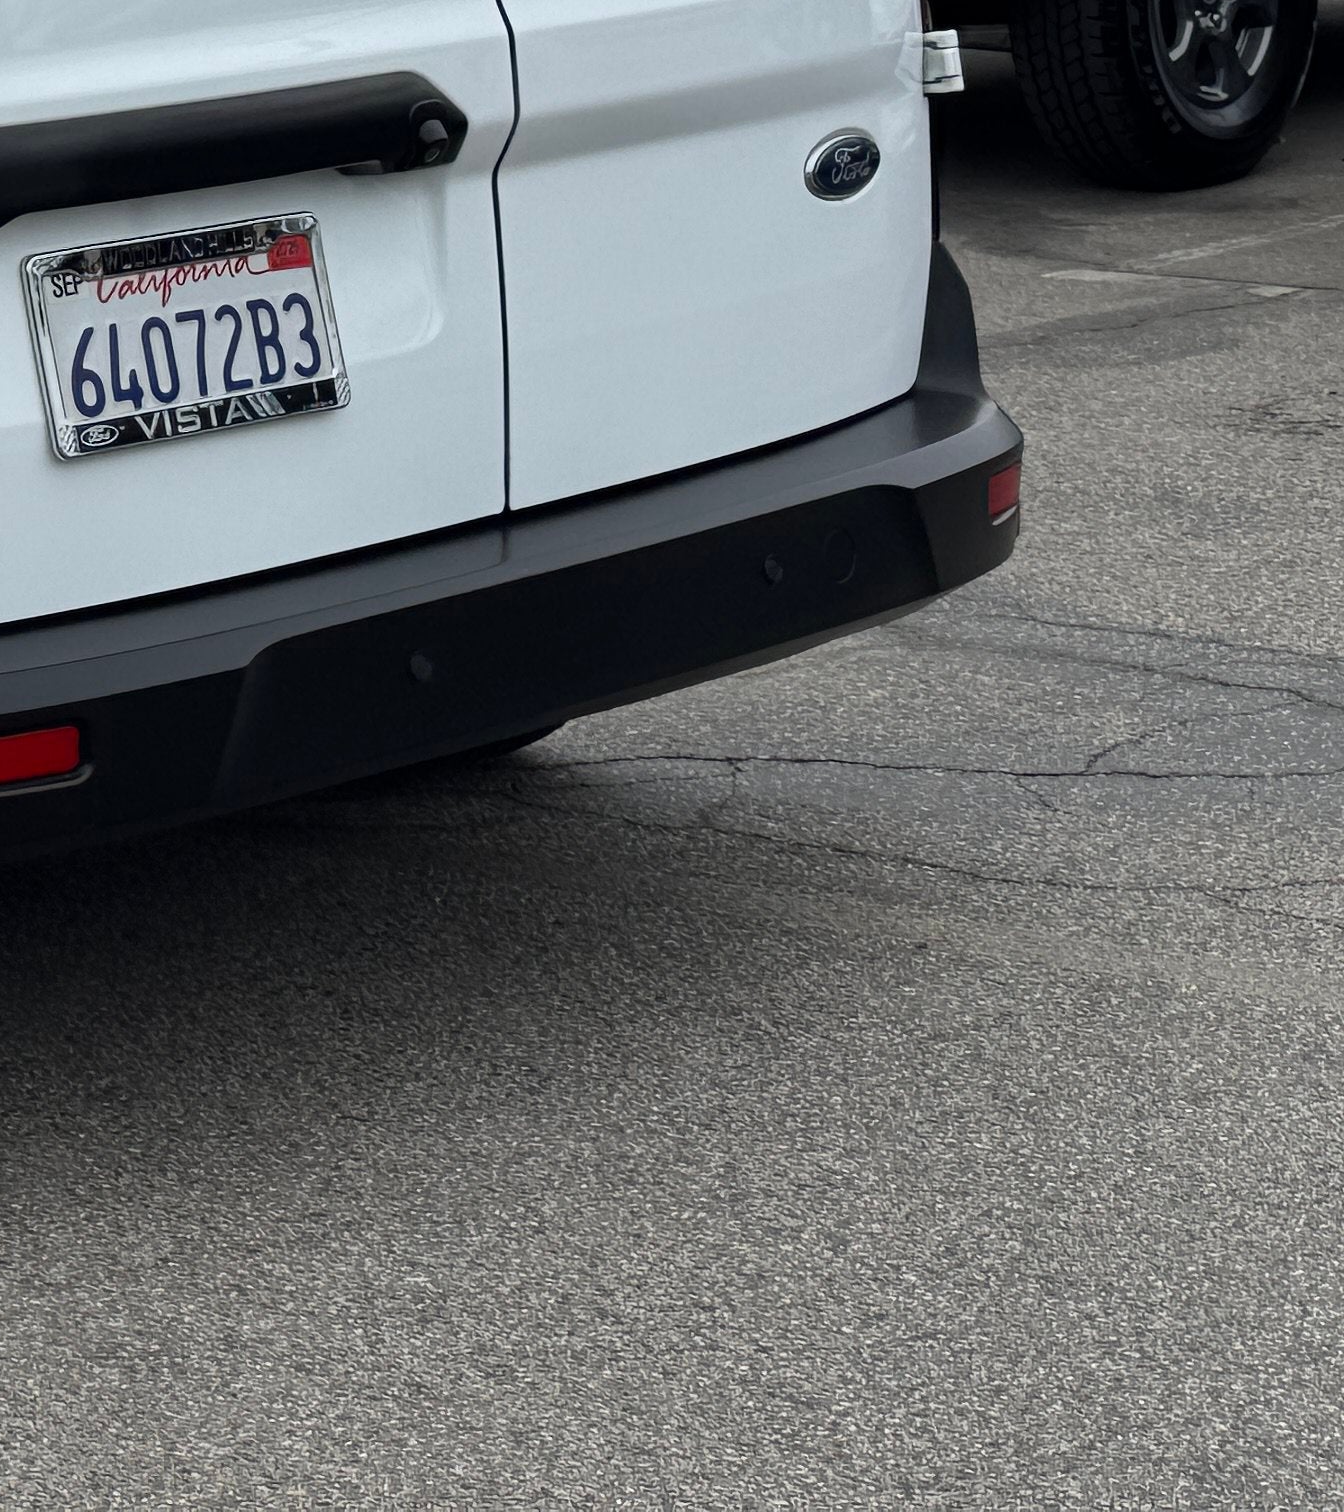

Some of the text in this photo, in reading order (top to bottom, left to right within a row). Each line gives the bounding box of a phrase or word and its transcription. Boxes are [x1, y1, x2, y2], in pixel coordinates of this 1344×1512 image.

[51, 275, 83, 298] SEP
[97, 255, 268, 306] California
[71, 292, 322, 418] 64072B3
[134, 397, 254, 439] VISTA
